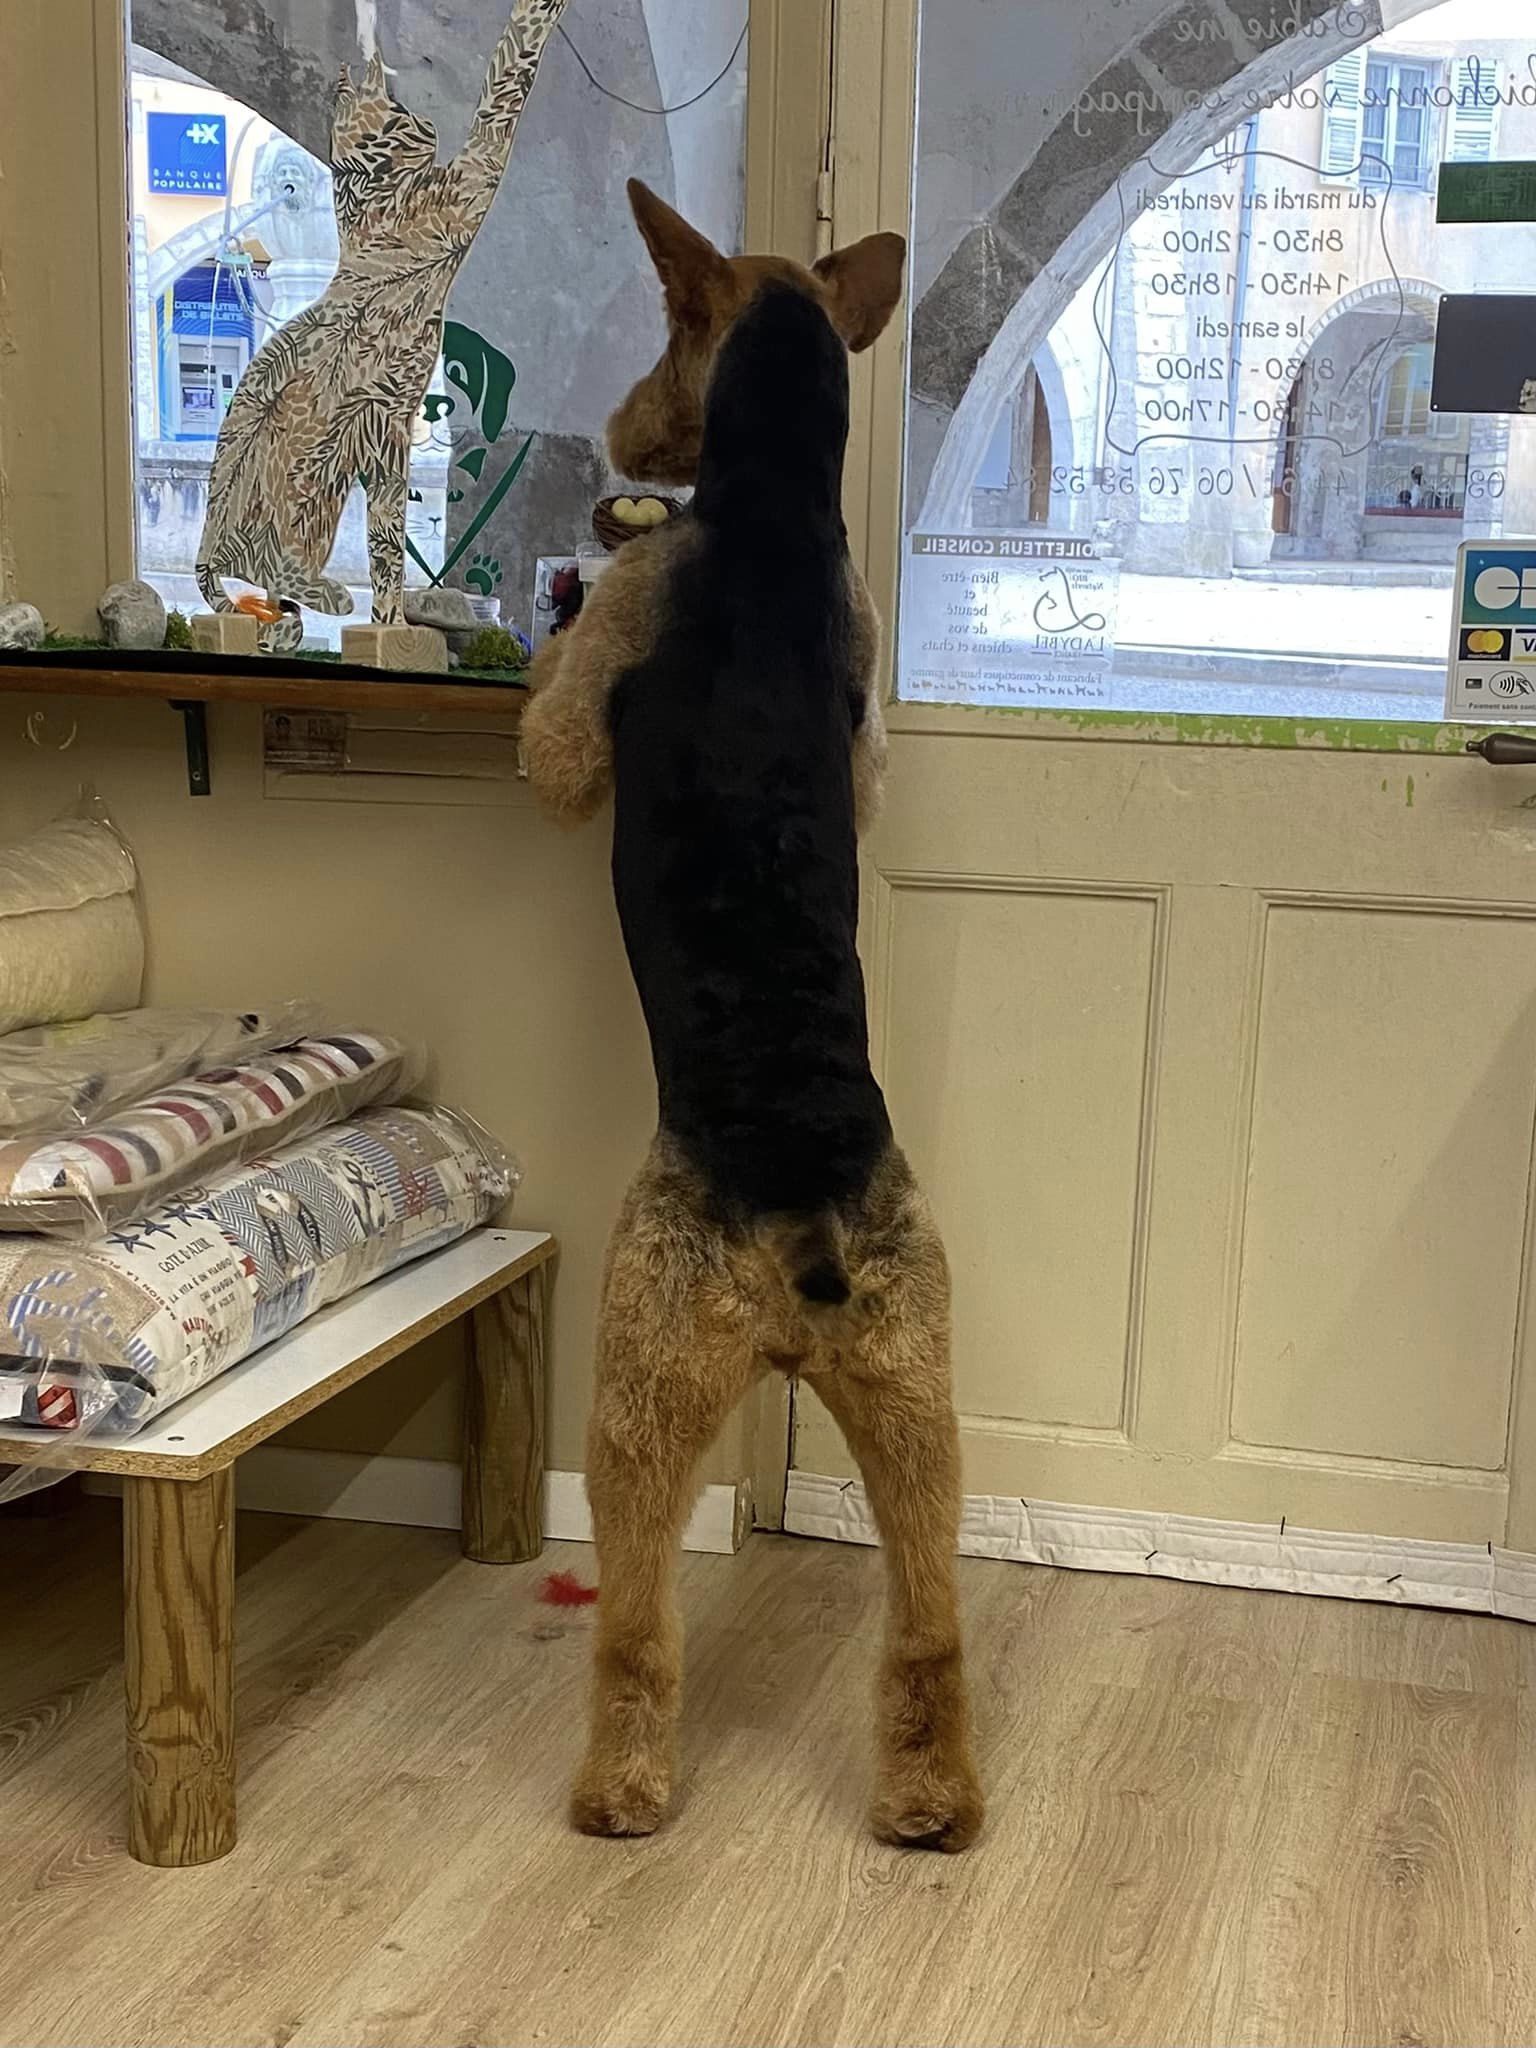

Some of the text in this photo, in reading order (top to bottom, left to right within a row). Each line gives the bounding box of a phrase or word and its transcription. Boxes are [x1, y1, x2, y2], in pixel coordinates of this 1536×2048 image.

[153, 167, 222, 180] BANQUE
[153, 179, 222, 191] POPULAIRE
[182, 310, 198, 320] DE
